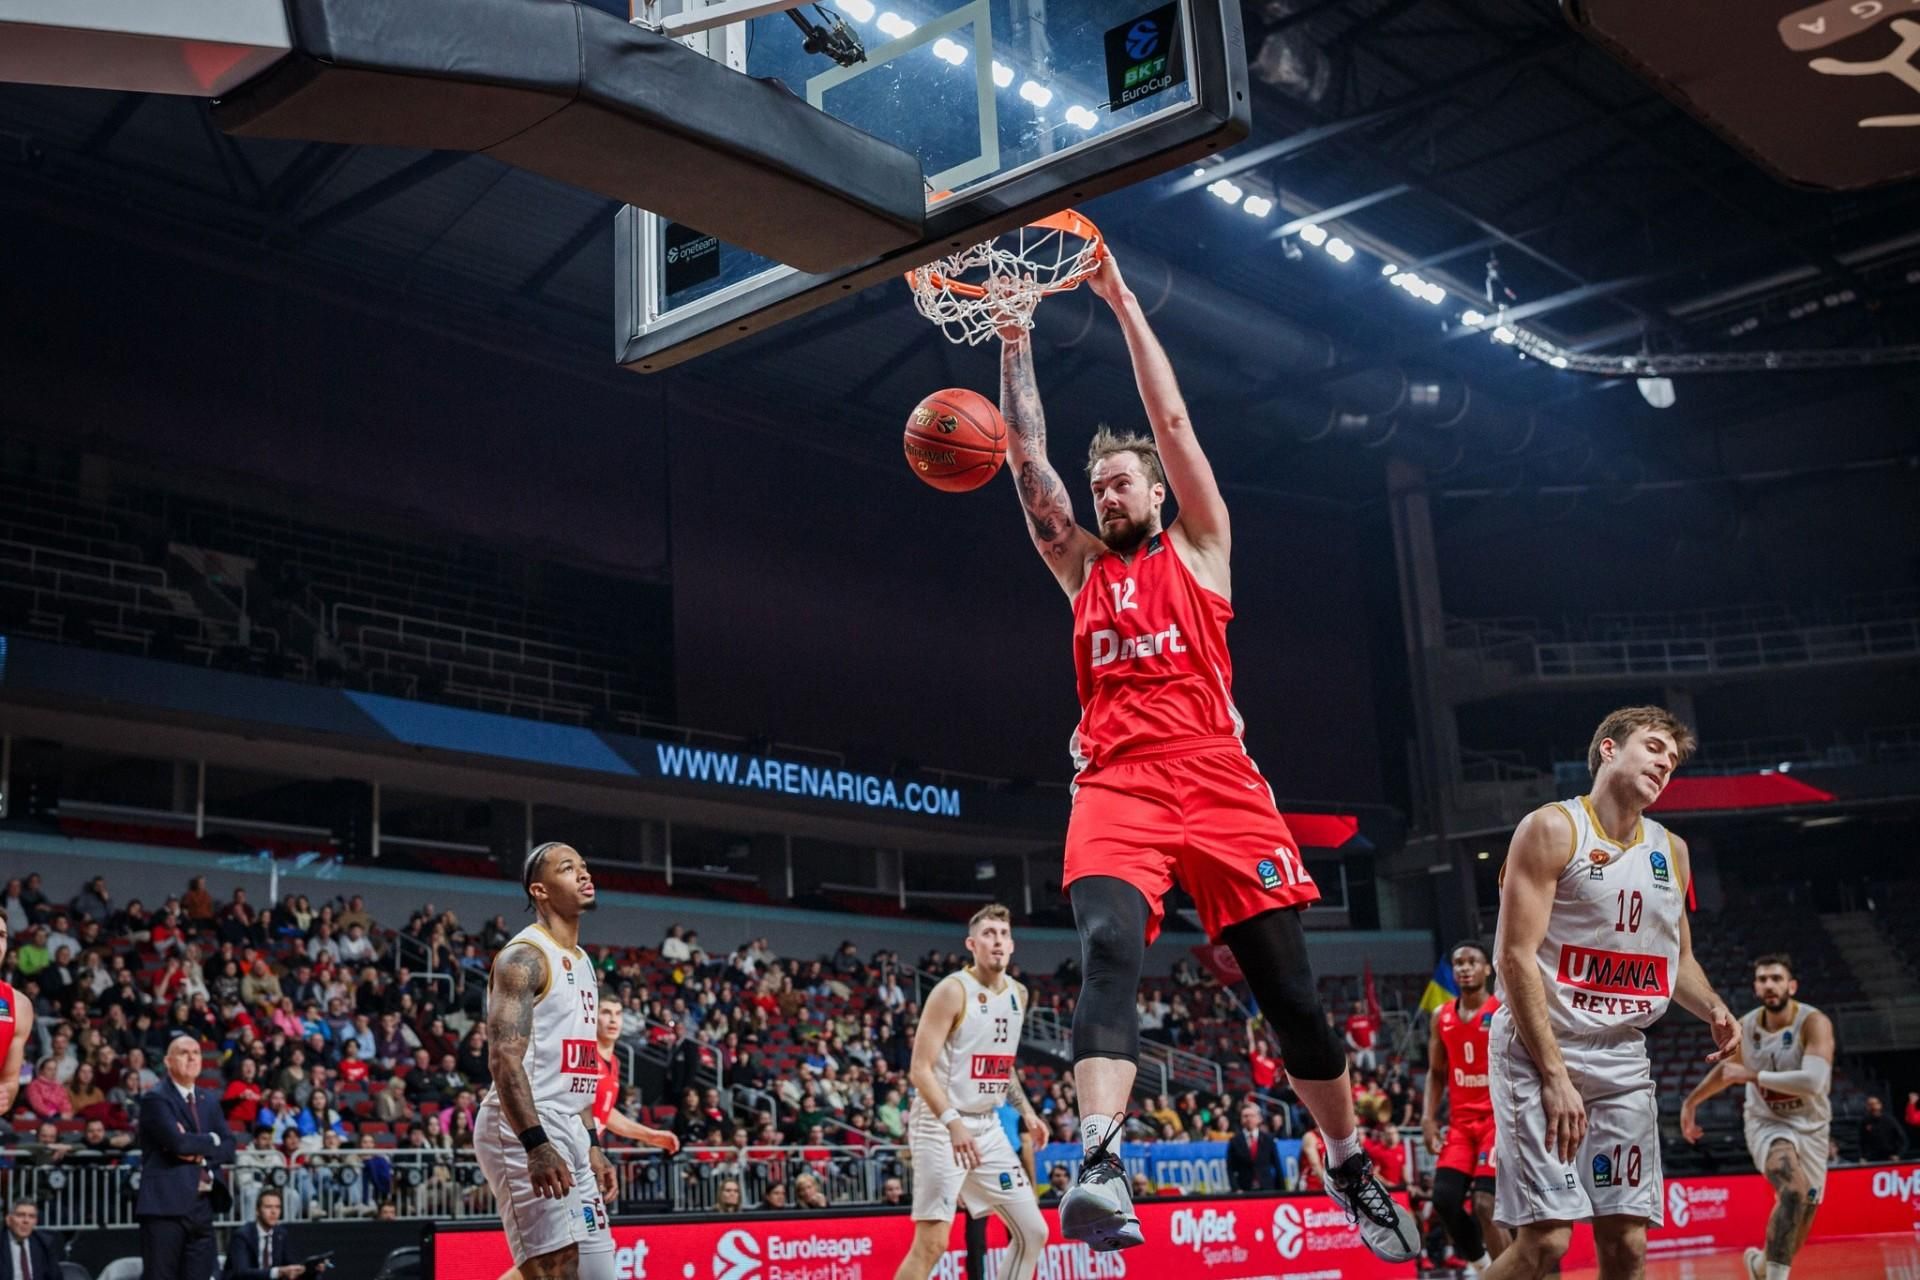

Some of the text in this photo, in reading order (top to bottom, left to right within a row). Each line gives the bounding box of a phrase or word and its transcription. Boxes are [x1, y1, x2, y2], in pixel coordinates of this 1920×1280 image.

[1123, 56, 1166, 84] BKT
[1121, 74, 1172, 103] EuroCup
[1111, 577, 1138, 613] 12
[656, 744, 960, 817] WWW.ARENARIGA.COM
[1615, 889, 1643, 933] 10
[1568, 952, 1661, 991] UMANA
[1572, 991, 1653, 1016] REYER
[993, 1018, 1008, 1043] 33
[567, 1043, 599, 1071] UMA
[1463, 1041, 1474, 1064] 0
[570, 1076, 598, 1094] REYE
[1612, 1143, 1642, 1187] 10
[1171, 1208, 1236, 1252] OlyBet
[768, 1235, 872, 1262] Euroleague
